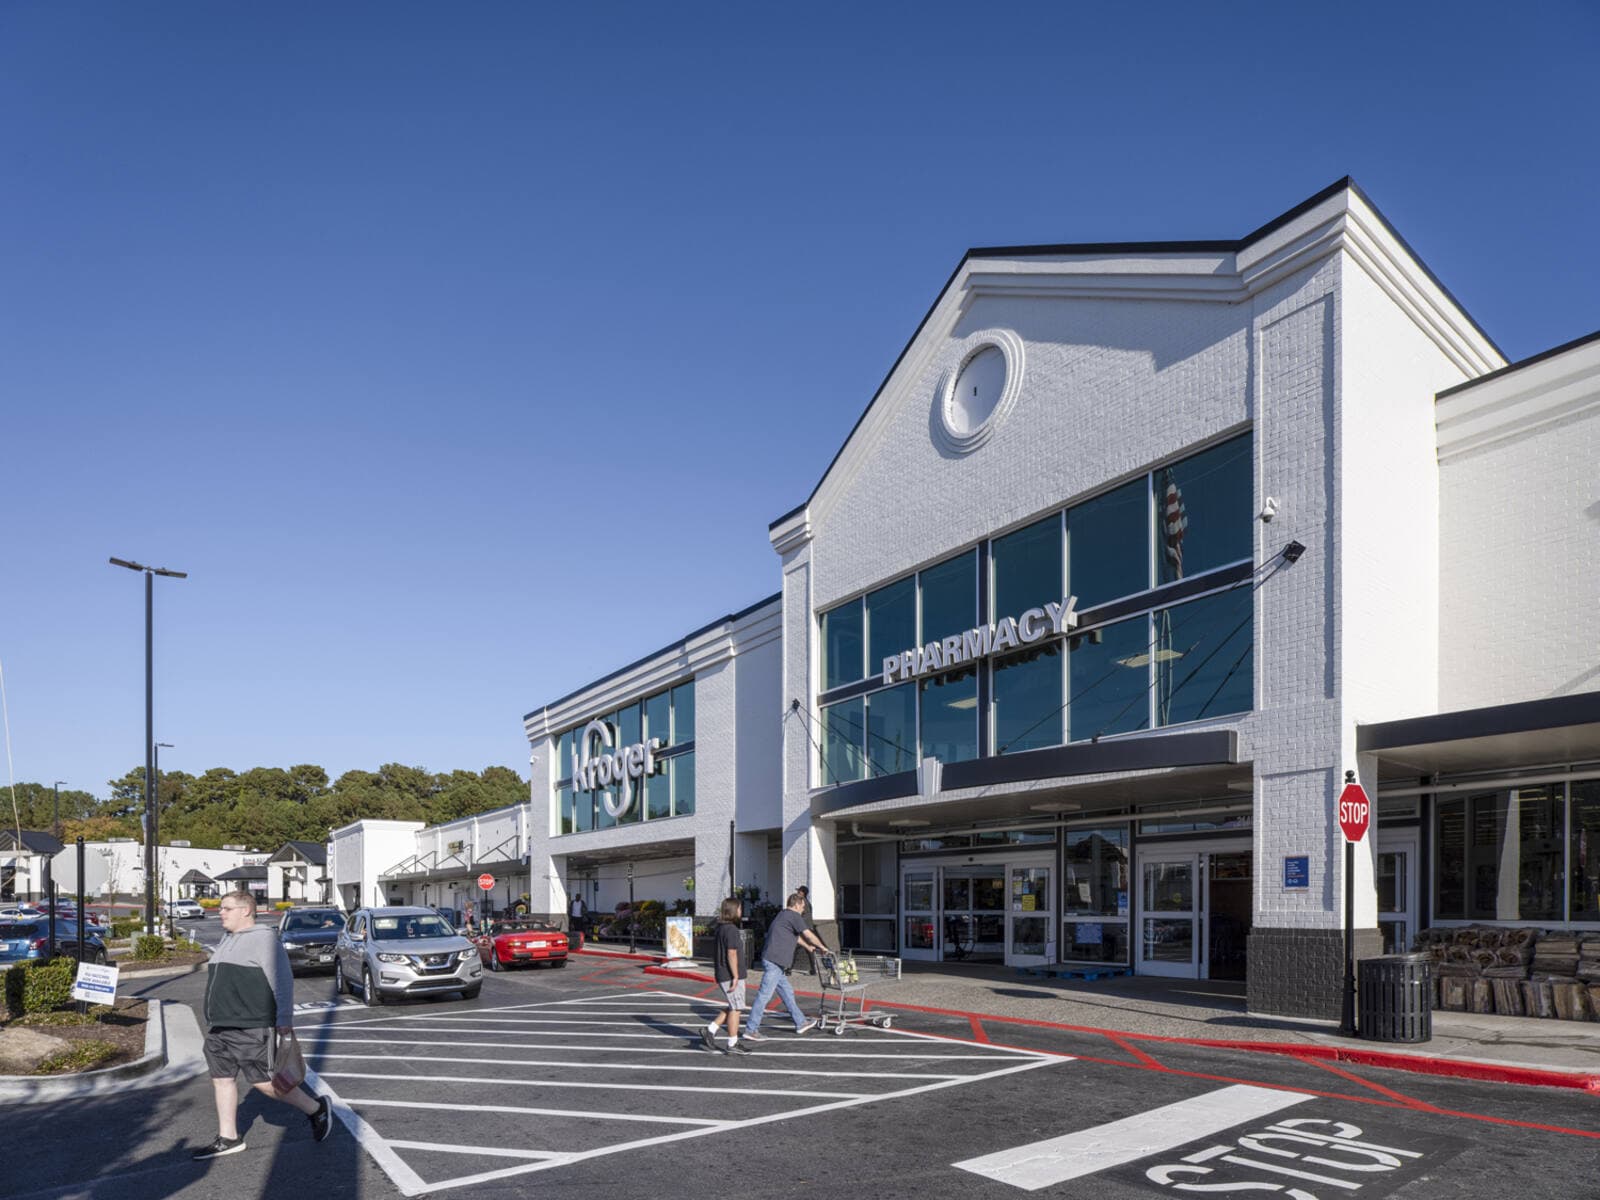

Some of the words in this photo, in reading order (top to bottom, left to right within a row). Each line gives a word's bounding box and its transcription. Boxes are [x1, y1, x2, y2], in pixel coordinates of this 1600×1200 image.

[882, 595, 1078, 684] PHARMACY
[572, 719, 660, 817] Kroger
[1340, 801, 1368, 824] STOP
[1146, 1118, 1424, 1200] STOP
